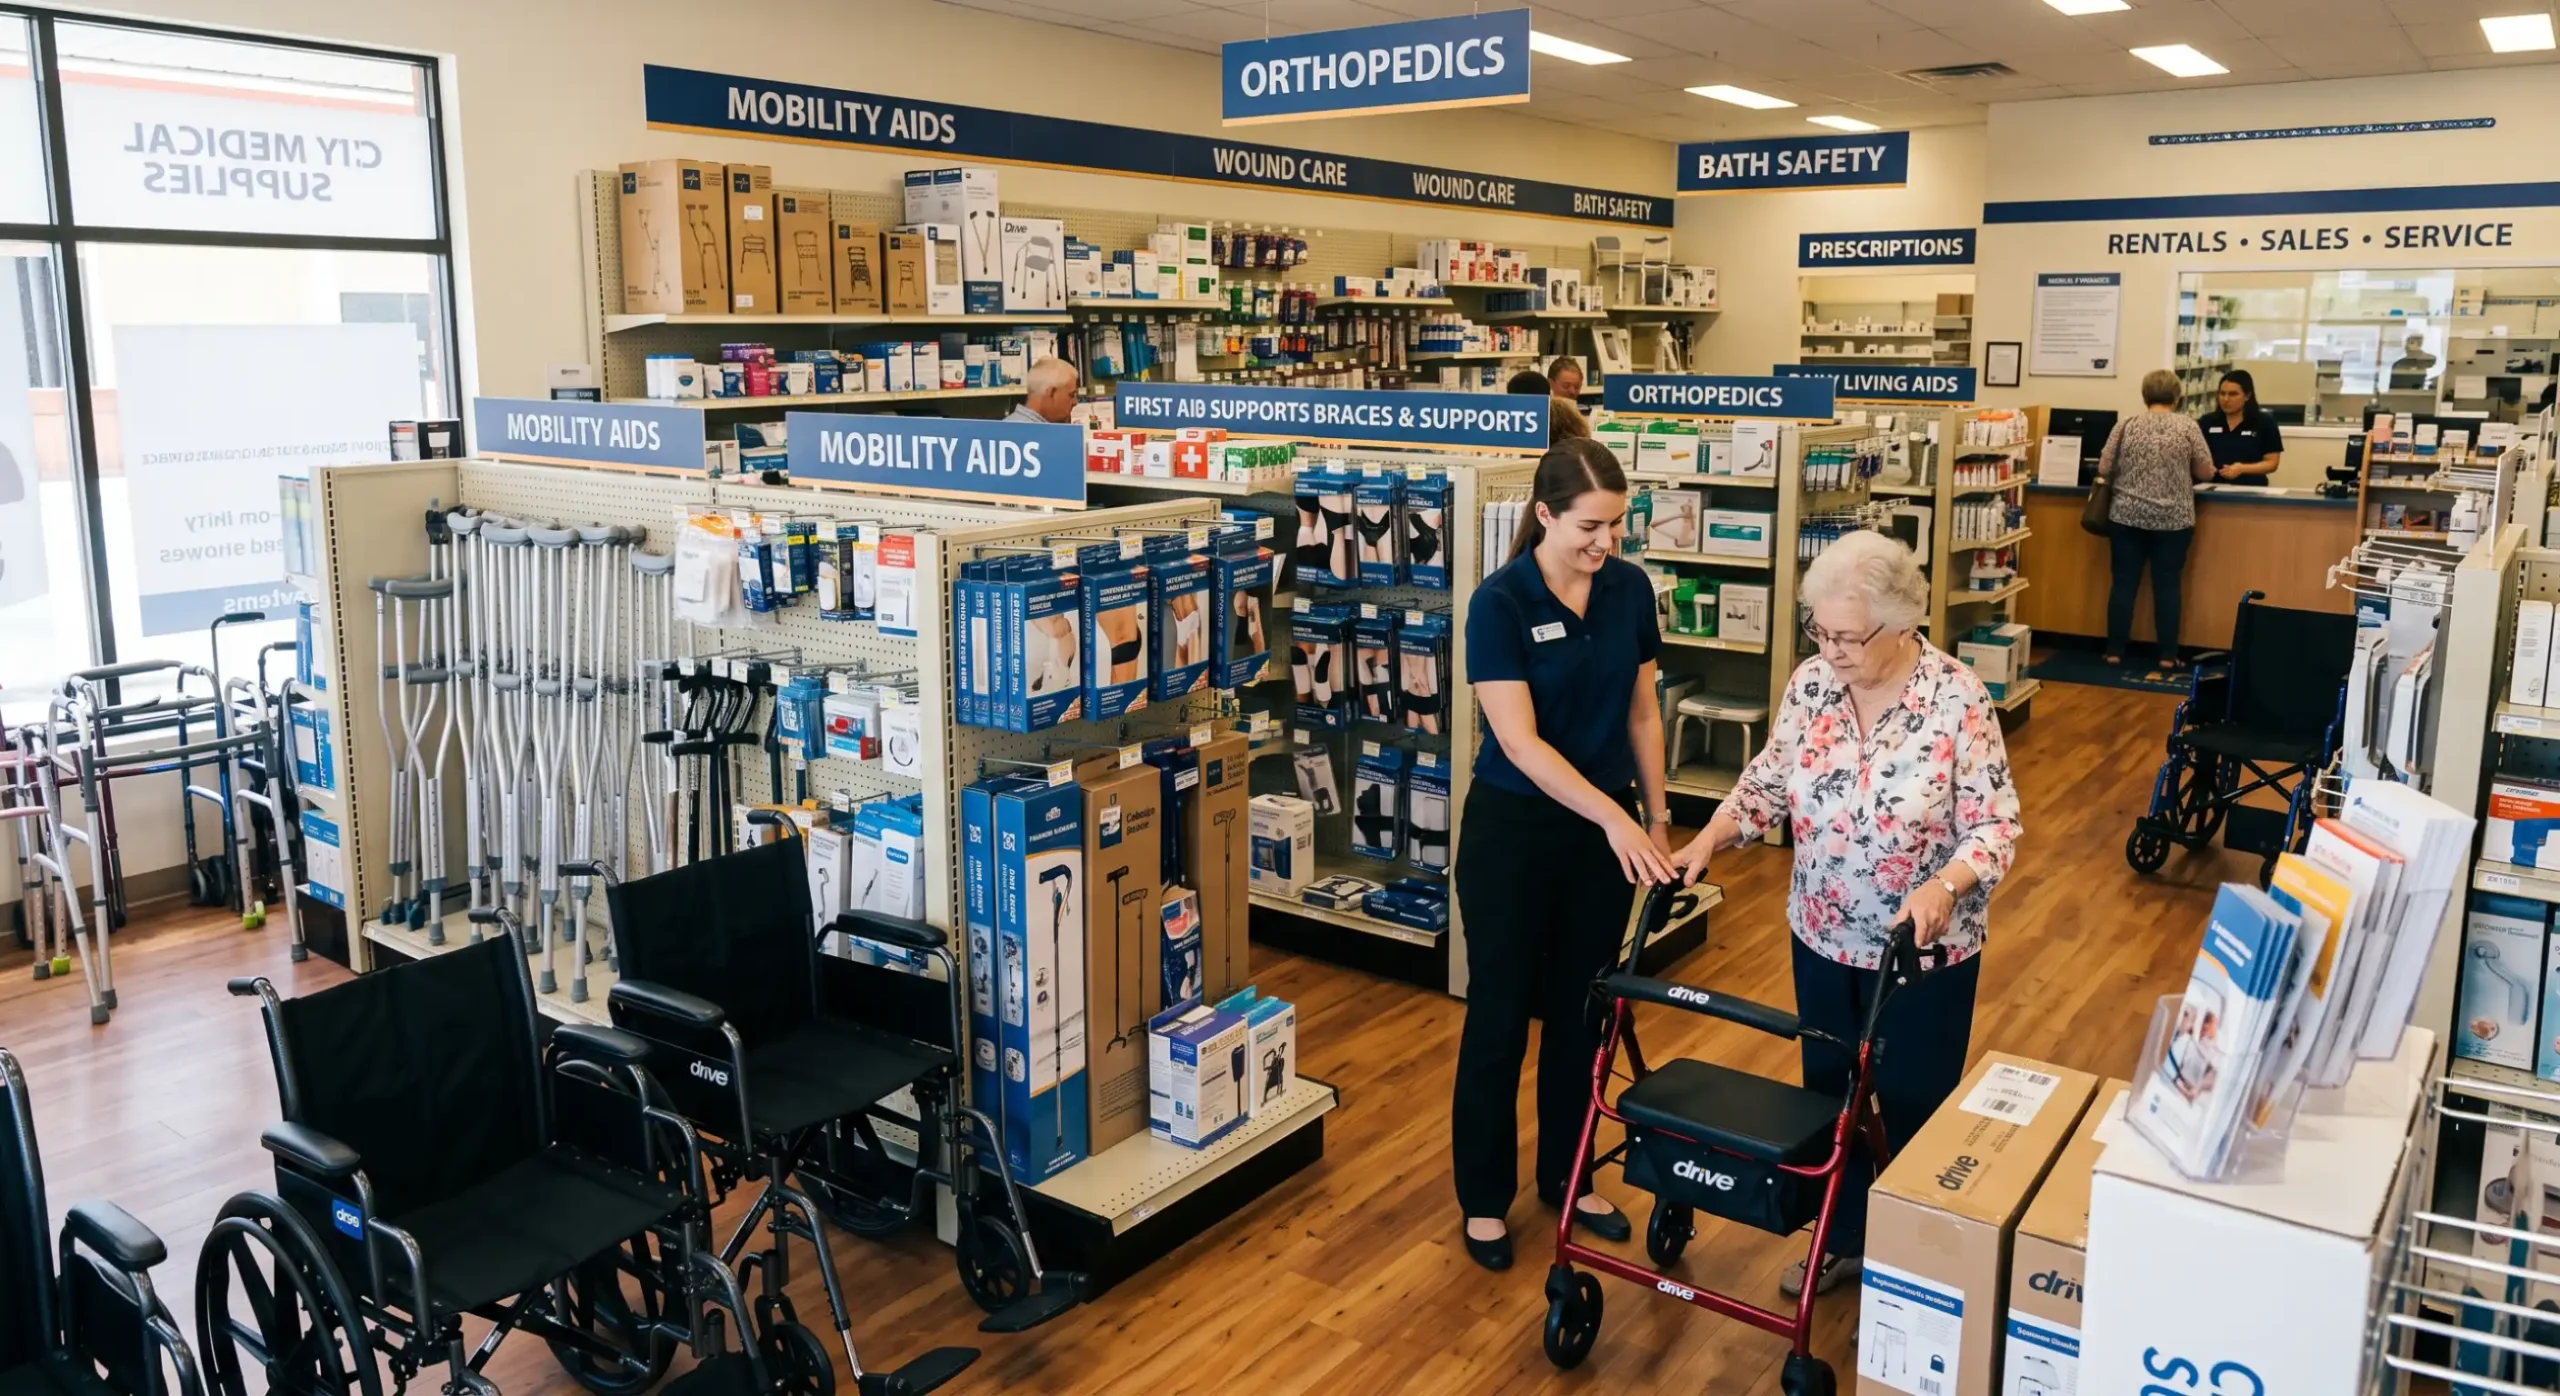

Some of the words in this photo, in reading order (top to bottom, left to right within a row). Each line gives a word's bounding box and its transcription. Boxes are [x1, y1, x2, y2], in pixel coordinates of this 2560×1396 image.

[1240, 35, 1505, 97] ORTHOPEDICS
[728, 86, 883, 136] MOBILITY
[889, 107, 956, 144] AIDS
[1212, 147, 1296, 180] WOUND
[1299, 158, 1347, 187] CARE
[1698, 151, 1770, 179] BATH
[1776, 145, 1887, 176] SAFETY
[1412, 172, 1475, 200] WOUND
[1477, 180, 1516, 205] CARE
[1573, 192, 1607, 216] BATH
[1608, 197, 1652, 221] SAFETY
[1808, 237, 1963, 259] PRESCRIPTIONS
[2108, 230, 2227, 255] RENTALS
[2260, 227, 2349, 252] SALES
[2384, 223, 2513, 249] SERVICE
[1628, 384, 1783, 407] ORTHOPEDICS
[1843, 374, 1908, 392] LIVING
[1911, 375, 1958, 393] AIDS
[1124, 395, 1174, 417] FIRST
[1210, 399, 1310, 423] SUPPORTS
[1313, 403, 1394, 427] BRACES
[1398, 406, 1415, 428] &
[1419, 407, 1538, 433] SUPPORTS
[507, 412, 604, 447] MOBILITY
[609, 418, 661, 451] AIDS
[820, 430, 959, 472] MOBILITY
[965, 438, 1041, 478] AIDS
[1667, 986, 1710, 1005] drive
[690, 1060, 729, 1087] drive
[1672, 1159, 1735, 1191] drive
[1935, 1155, 1980, 1191] drive
[1657, 1278, 1695, 1301] drive
[2028, 1270, 2083, 1304] driv
